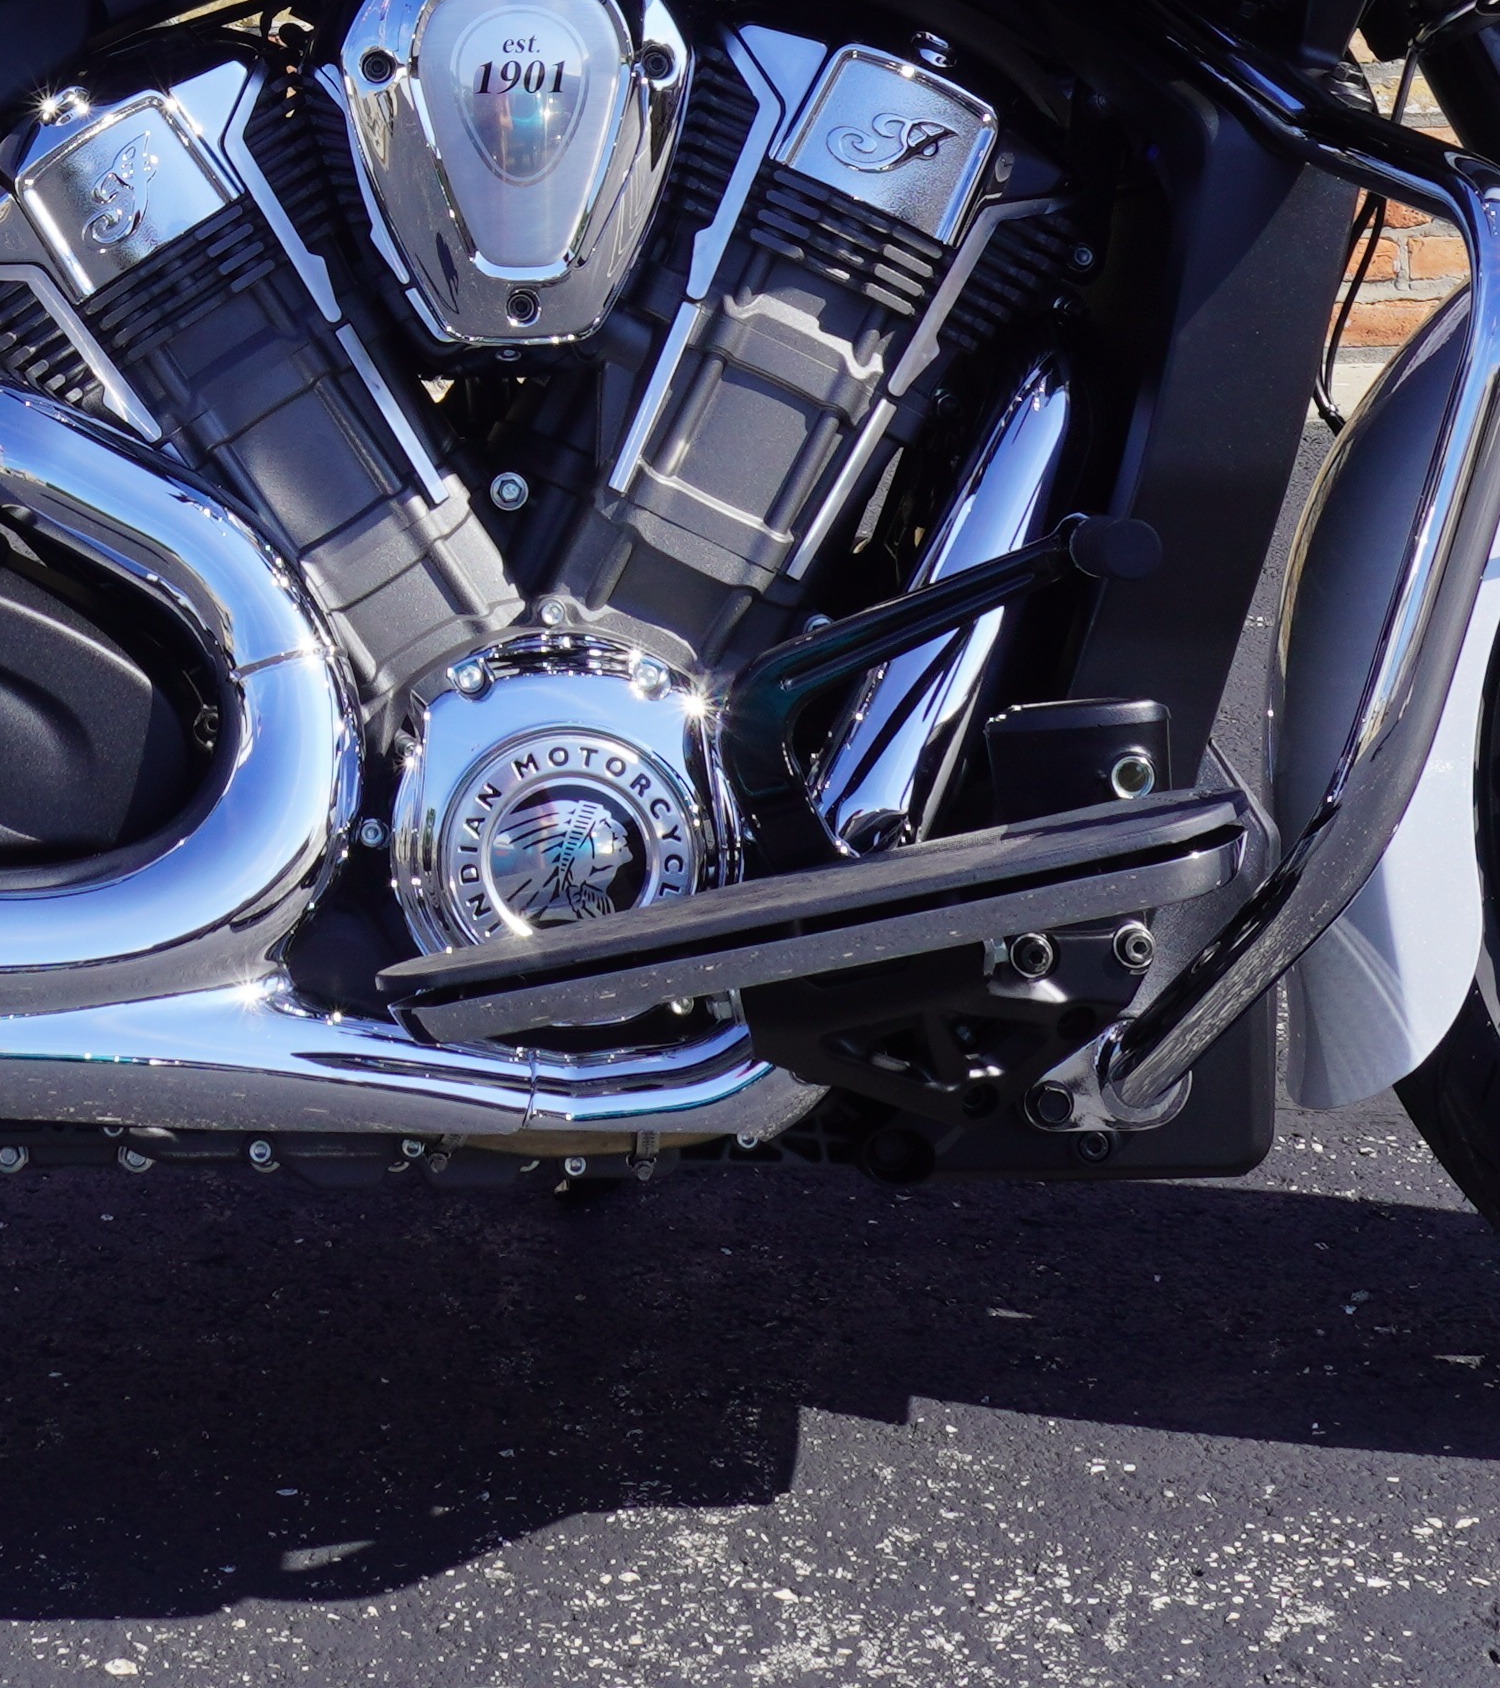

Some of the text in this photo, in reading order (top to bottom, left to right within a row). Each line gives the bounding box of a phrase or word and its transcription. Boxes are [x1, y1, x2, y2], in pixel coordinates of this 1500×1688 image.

[500, 32, 541, 57] est.
[474, 59, 569, 96] 1901
[457, 745, 686, 938] INDIAN MOTORCYCL
